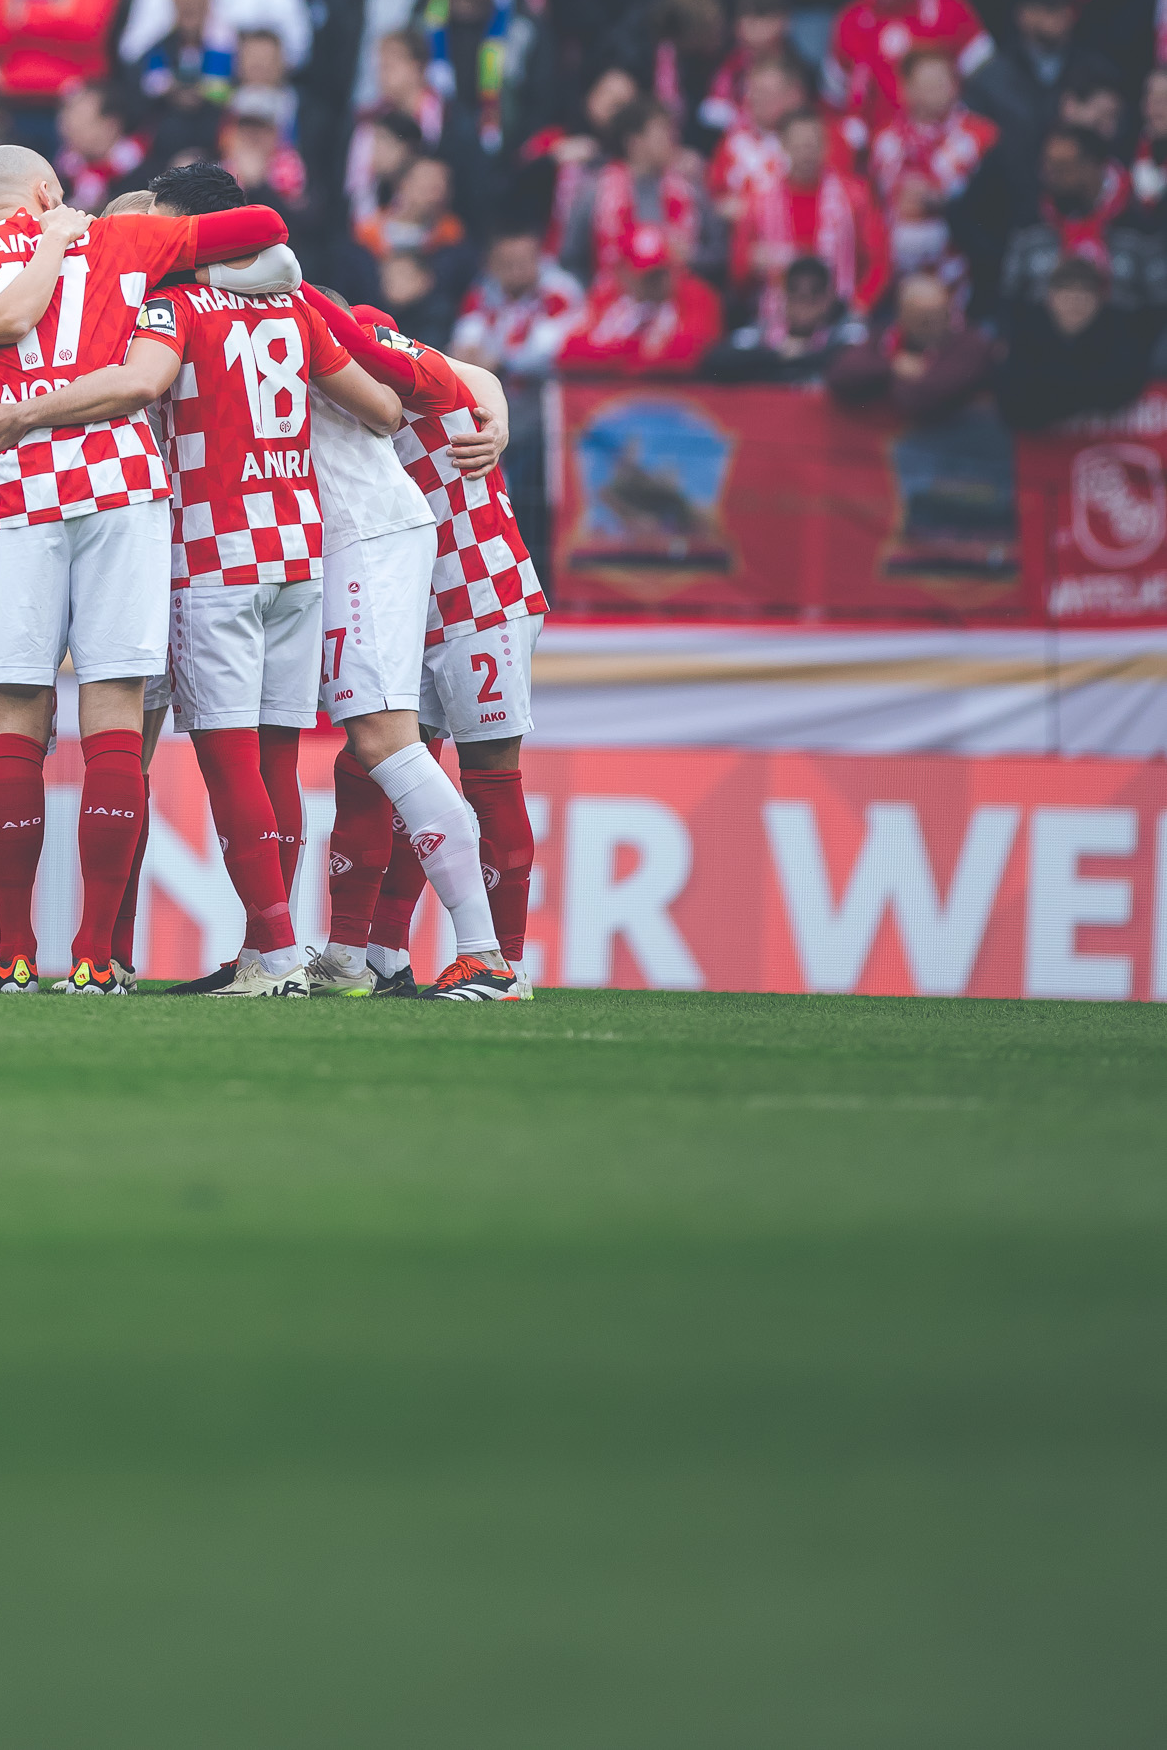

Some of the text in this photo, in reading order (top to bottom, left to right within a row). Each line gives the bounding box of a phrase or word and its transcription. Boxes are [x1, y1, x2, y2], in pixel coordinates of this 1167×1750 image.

[224, 317, 307, 439] 18
[471, 653, 502, 704] 2
[479, 711, 506, 724] JAKO
[85, 806, 135, 818] JAKO
[762, 798, 1167, 999] WE
